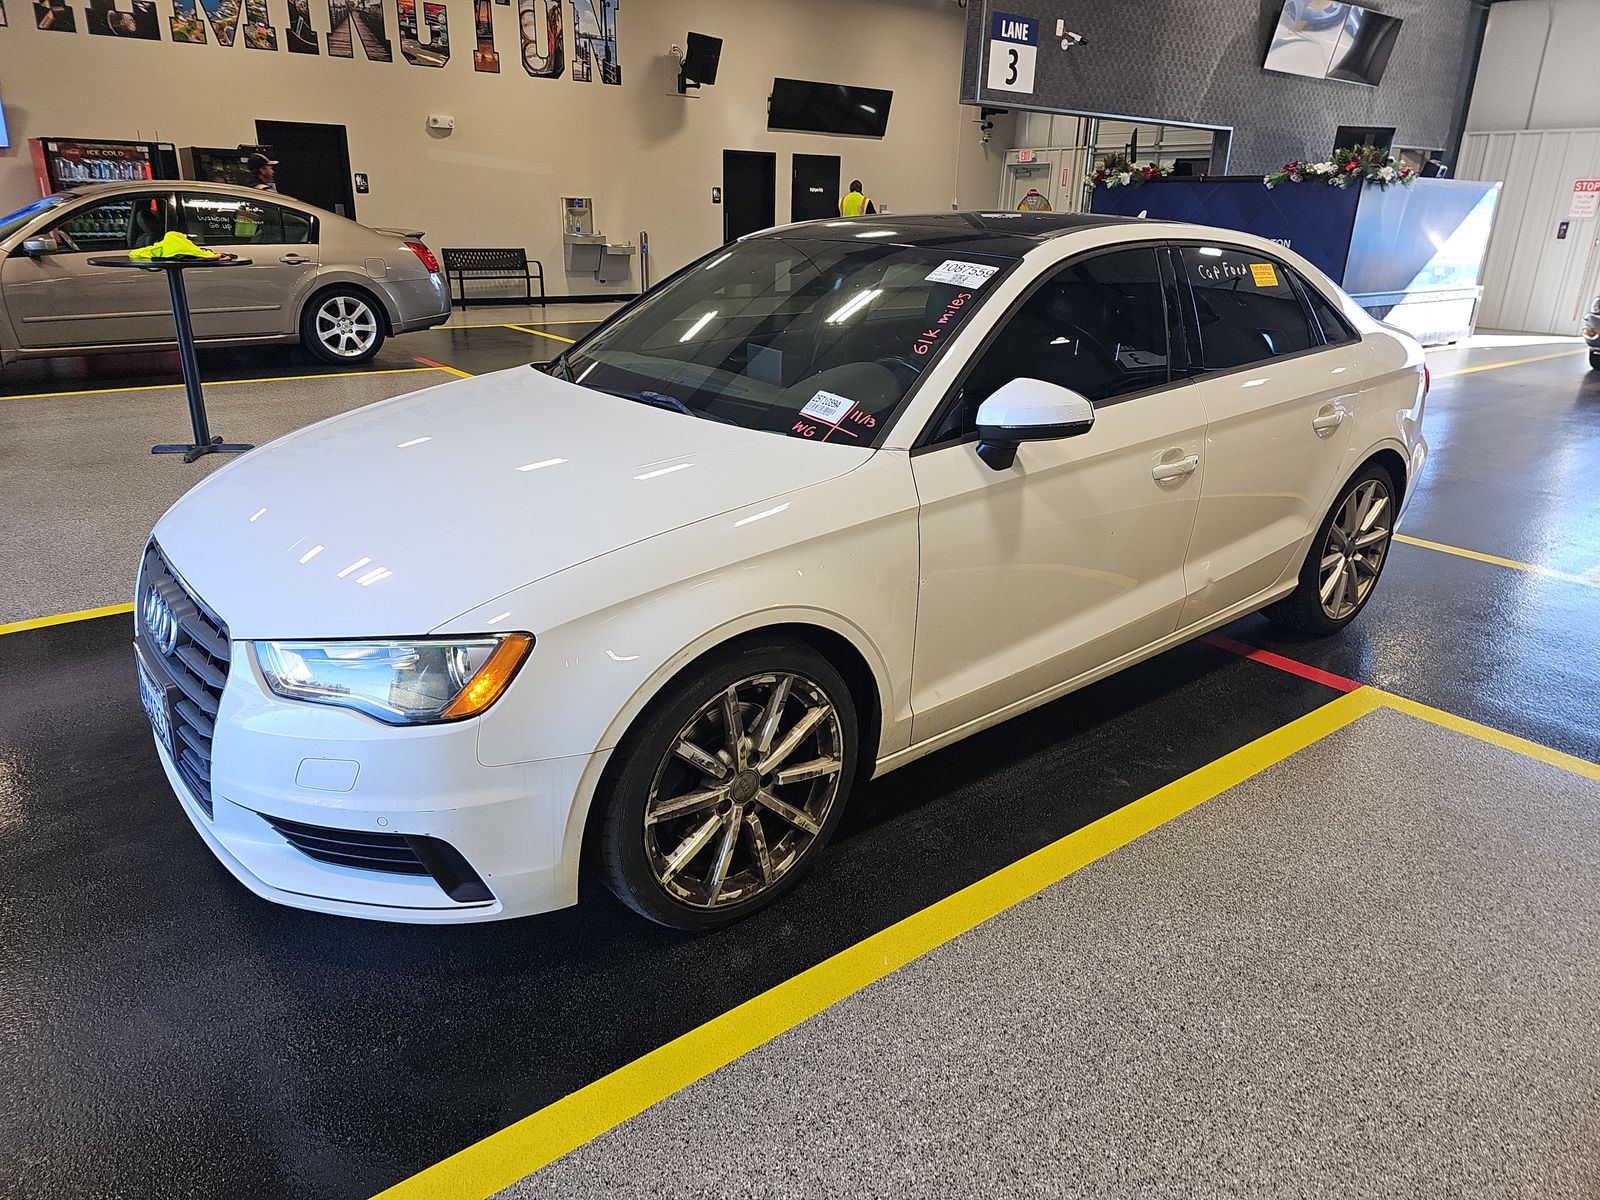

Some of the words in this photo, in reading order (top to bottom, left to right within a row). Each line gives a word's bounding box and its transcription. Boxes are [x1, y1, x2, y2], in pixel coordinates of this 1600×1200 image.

[1001, 19, 1029, 41] LANE
[1005, 48, 1019, 86] 3
[1575, 181, 1600, 191] STOP
[941, 262, 995, 278] 1087559
[937, 292, 972, 324] miles
